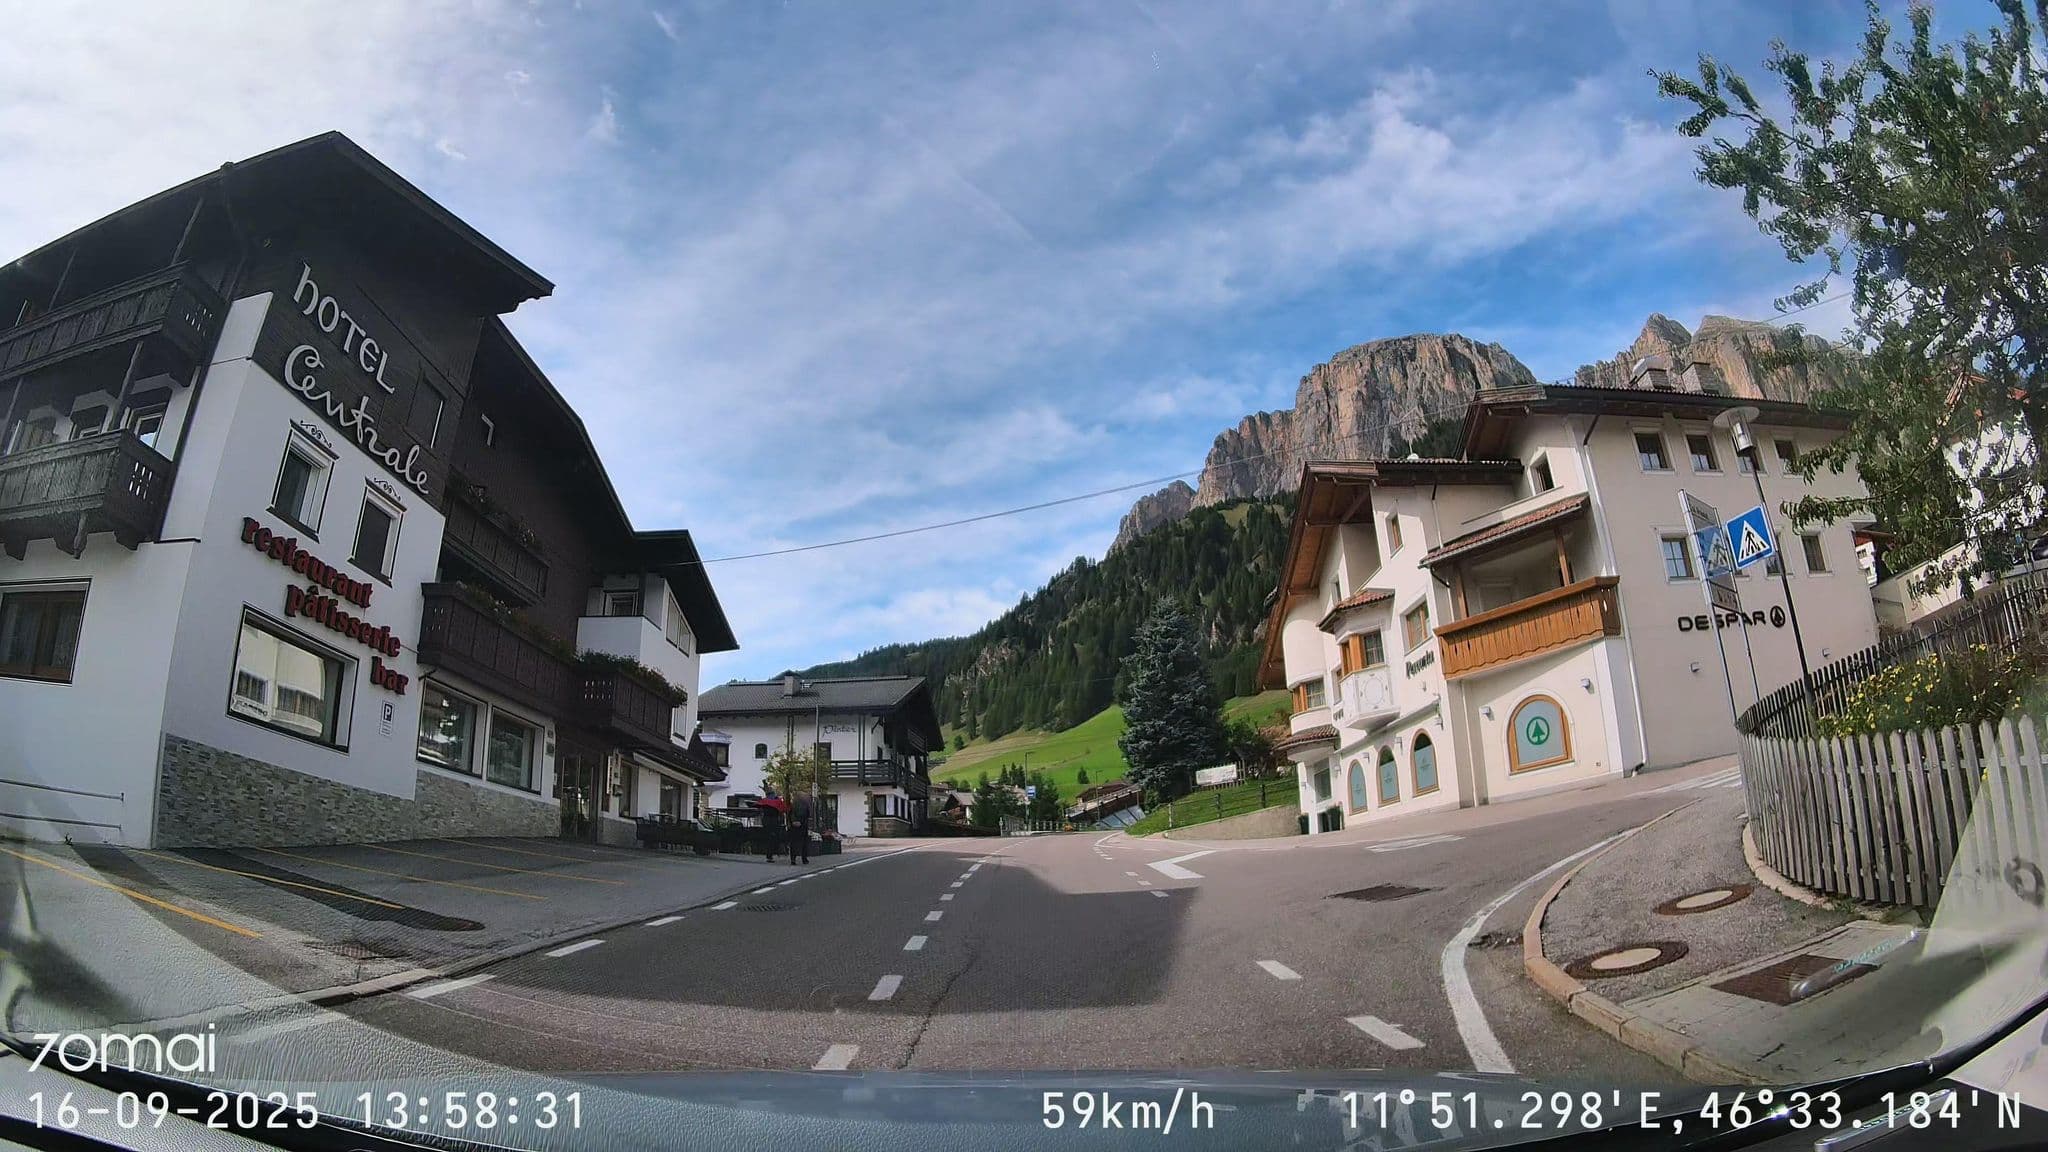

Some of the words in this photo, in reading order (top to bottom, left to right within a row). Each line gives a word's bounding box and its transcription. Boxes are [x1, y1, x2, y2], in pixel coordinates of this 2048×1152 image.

[284, 344, 429, 494] Centrale
[241, 517, 374, 608] restaurant
[284, 583, 402, 657] pâtisserie
[1677, 611, 1767, 632] DESPAR
[370, 656, 409, 695] bar
